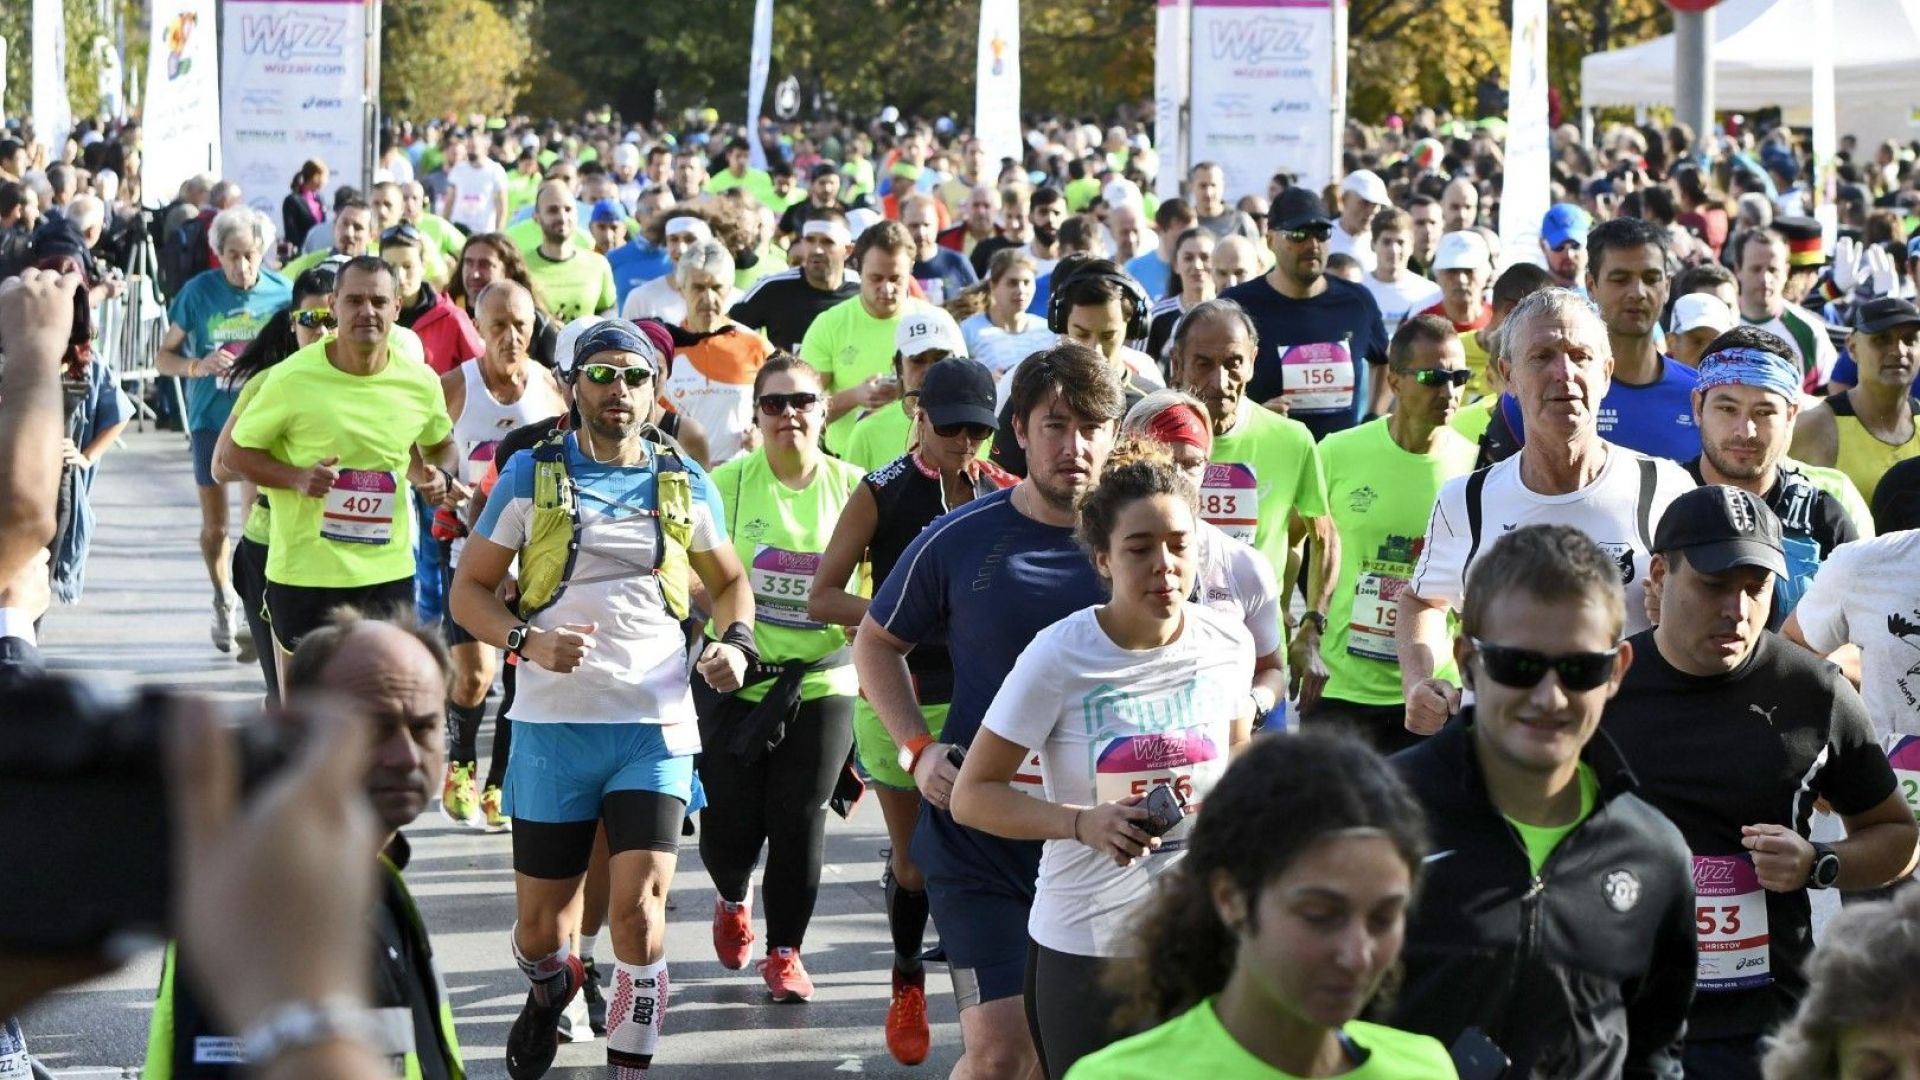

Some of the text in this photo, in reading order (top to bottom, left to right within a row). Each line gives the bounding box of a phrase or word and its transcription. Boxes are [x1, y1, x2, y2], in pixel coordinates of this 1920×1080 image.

[264, 64, 345, 74] wizzair.com
[1302, 368, 1335, 385] 156
[343, 497, 382, 514] 407
[762, 575, 811, 596] 335
[1696, 905, 1741, 935] 53
[1705, 942, 1741, 950] HRISTOV
